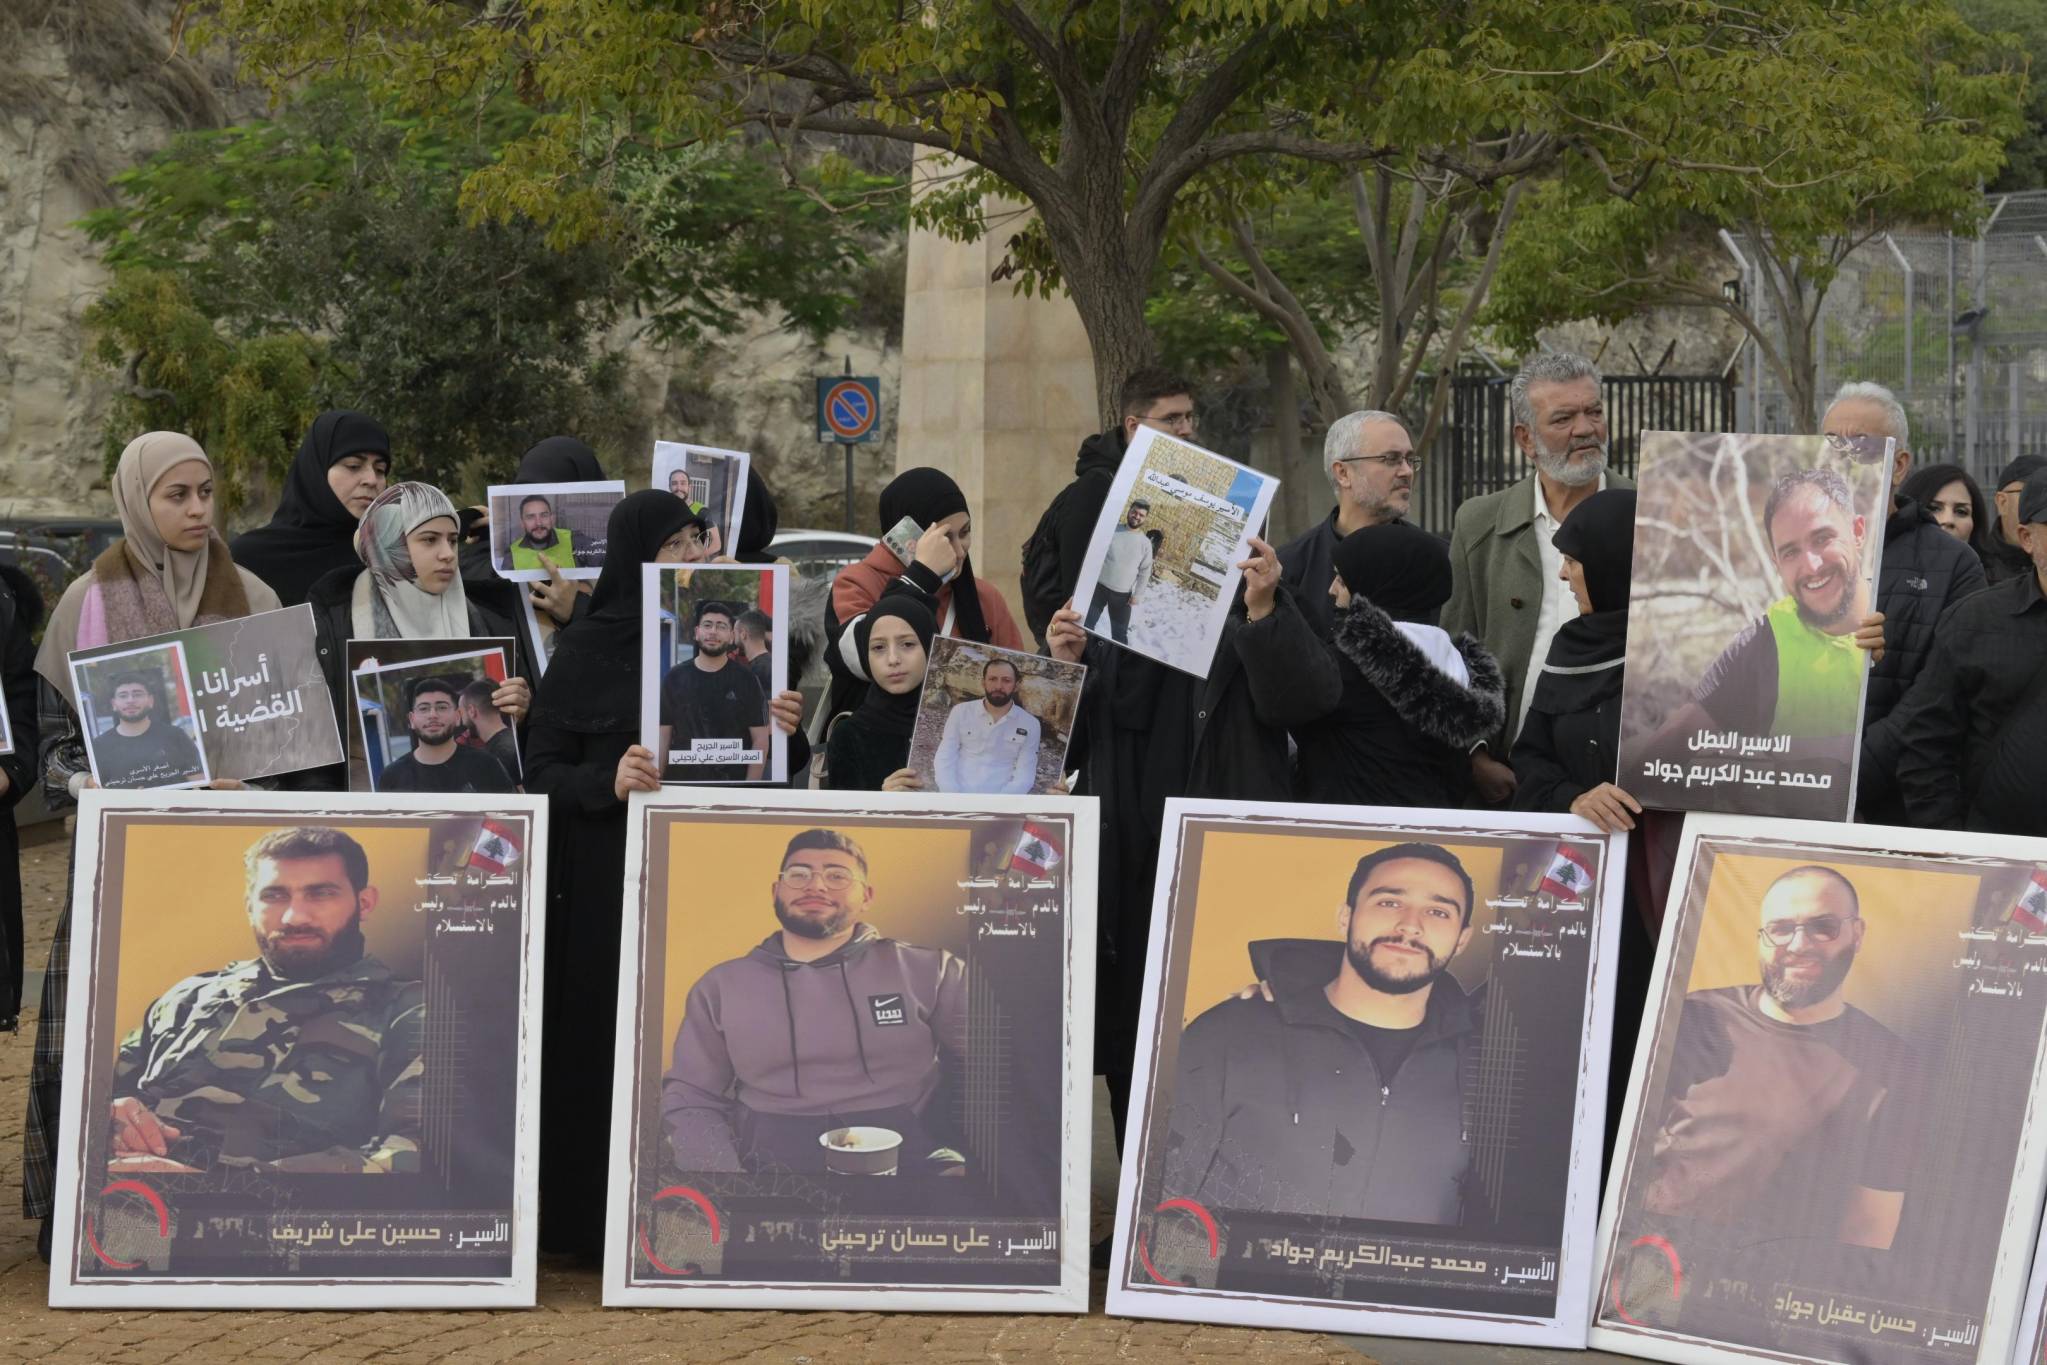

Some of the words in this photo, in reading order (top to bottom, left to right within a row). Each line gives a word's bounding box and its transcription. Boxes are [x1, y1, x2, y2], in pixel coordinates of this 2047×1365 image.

[215, 688, 304, 733] القضية
[696, 741, 718, 753] الجريح
[1687, 729, 1738, 754] البطل
[1643, 758, 1684, 784] جواد
[1686, 763, 1741, 788] الكريم
[1743, 769, 1776, 789] عبد
[1778, 771, 1832, 789] محمد
[415, 871, 461, 888] تكتب
[466, 871, 518, 889] الكرامة
[957, 875, 1004, 891] تكتب
[1008, 875, 1059, 893] الكرامة
[414, 895, 444, 912] وليس
[490, 895, 517, 914] بالدم
[956, 897, 986, 915] وليس
[1032, 898, 1059, 918] بالدم
[1484, 894, 1532, 910] تكتب
[1537, 895, 1590, 914] الكرامة
[435, 919, 495, 937] بالاستسلام
[978, 922, 1036, 940] بالاستسلام
[1482, 917, 1512, 934] وليس
[1559, 921, 1587, 940] بالدم
[2006, 929, 2047, 949] كرامة
[1502, 941, 1562, 961] بالاستسلام
[1952, 951, 1981, 970] وليس
[272, 1220, 334, 1246] شريف
[382, 1223, 441, 1247] حسين
[891, 1226, 947, 1252] حسان
[1270, 1237, 1315, 1265] جواد
[1430, 1256, 1487, 1273] محمد
[1774, 1291, 1815, 1320] جواد
[1817, 1298, 1867, 1325] عقيل
[1869, 1309, 1917, 1334] حسن
